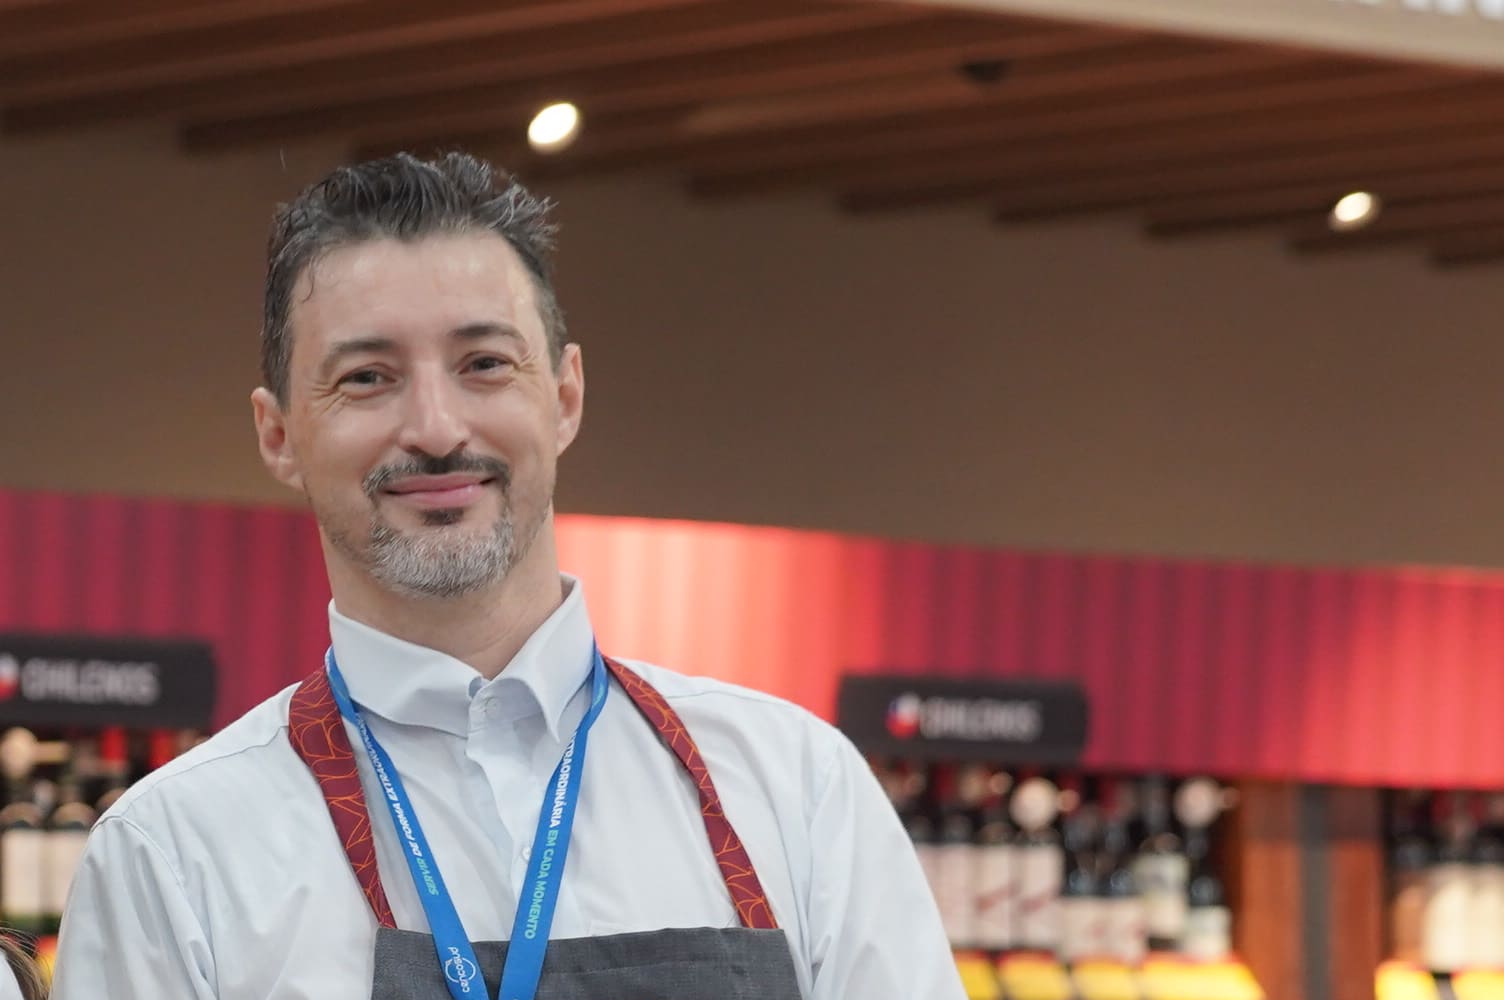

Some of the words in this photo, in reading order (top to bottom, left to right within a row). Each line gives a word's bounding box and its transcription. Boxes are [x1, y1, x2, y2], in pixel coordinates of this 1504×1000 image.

[545, 829, 559, 847] EM
[537, 848, 555, 879] CADA
[524, 880, 548, 940] MOMENTO
